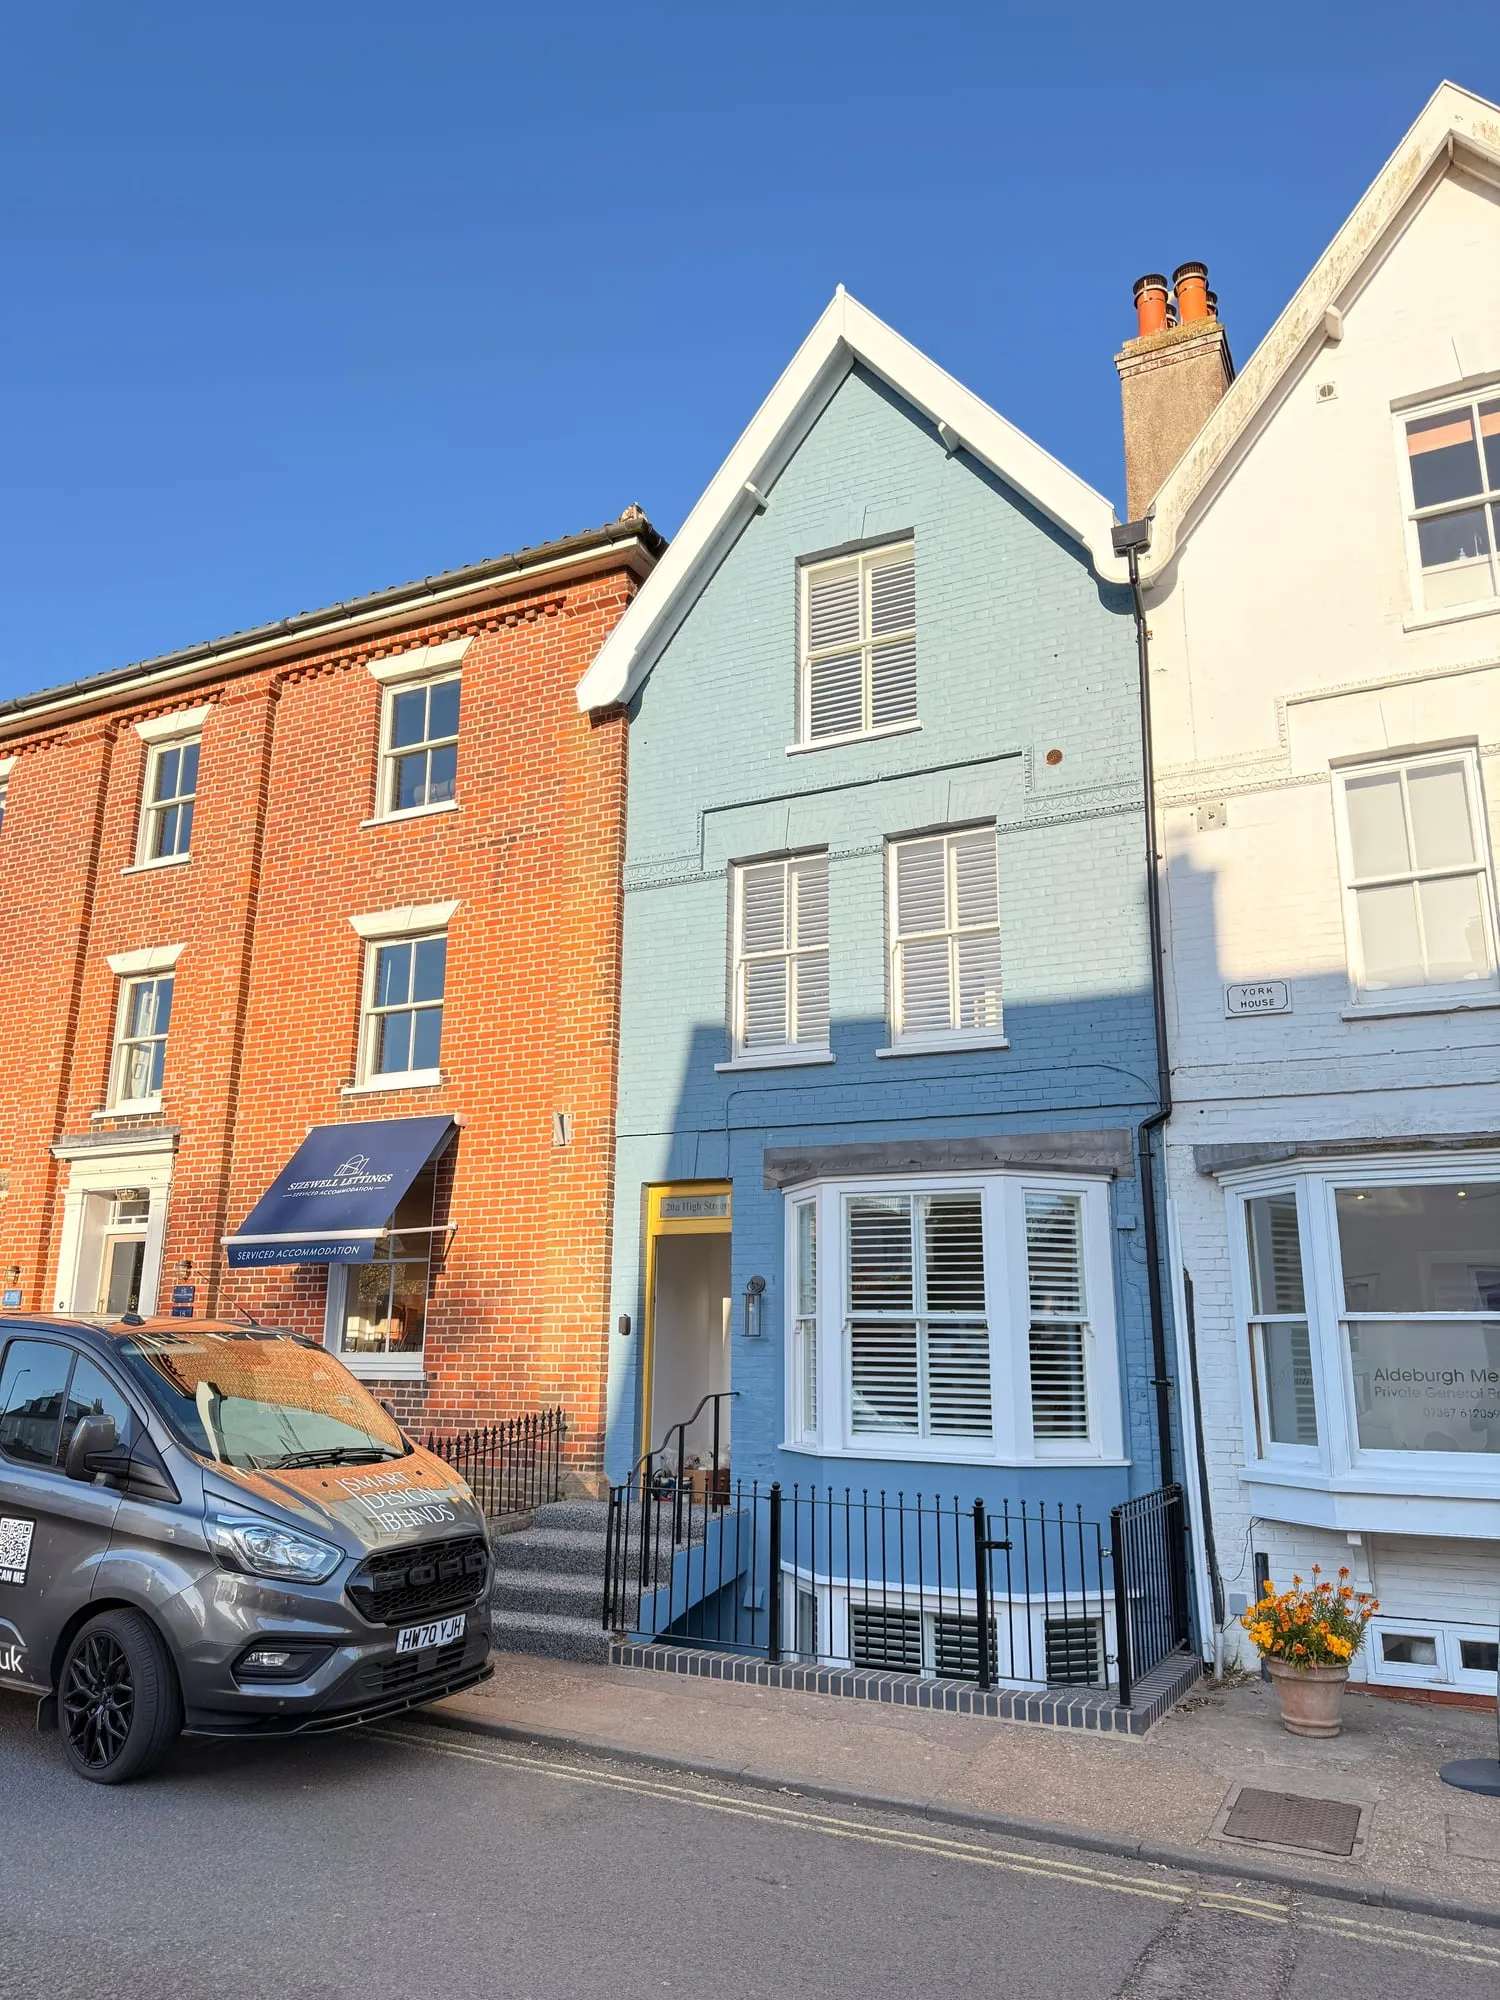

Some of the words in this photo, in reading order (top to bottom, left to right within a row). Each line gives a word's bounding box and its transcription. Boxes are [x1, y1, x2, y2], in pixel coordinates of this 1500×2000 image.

[1241, 987, 1273, 996] YORK
[1240, 998, 1275, 1008] HOUSE
[288, 1179, 338, 1190] SIZEWELL
[339, 1171, 394, 1186] LETTINGS
[291, 1190, 319, 1198] SERVICED
[319, 1186, 374, 1196] ACCOMMODATION
[682, 1201, 702, 1213] High
[237, 1250, 275, 1261] SERVICED
[276, 1246, 360, 1258] ACCOMMODATION
[1374, 1368, 1465, 1386] Aldeburgh
[1470, 1369, 1499, 1383] Me
[1374, 1386, 1421, 1398] Private
[1425, 1387, 1484, 1400] General
[341, 1471, 412, 1492] SMART
[361, 1486, 440, 1509] DESIGN
[381, 1504, 455, 1532] BLINDS
[12, 1571, 26, 1584] ME
[373, 1552, 487, 1593] FORD
[402, 1626, 437, 1651] HW70
[438, 1616, 463, 1643] YJH
